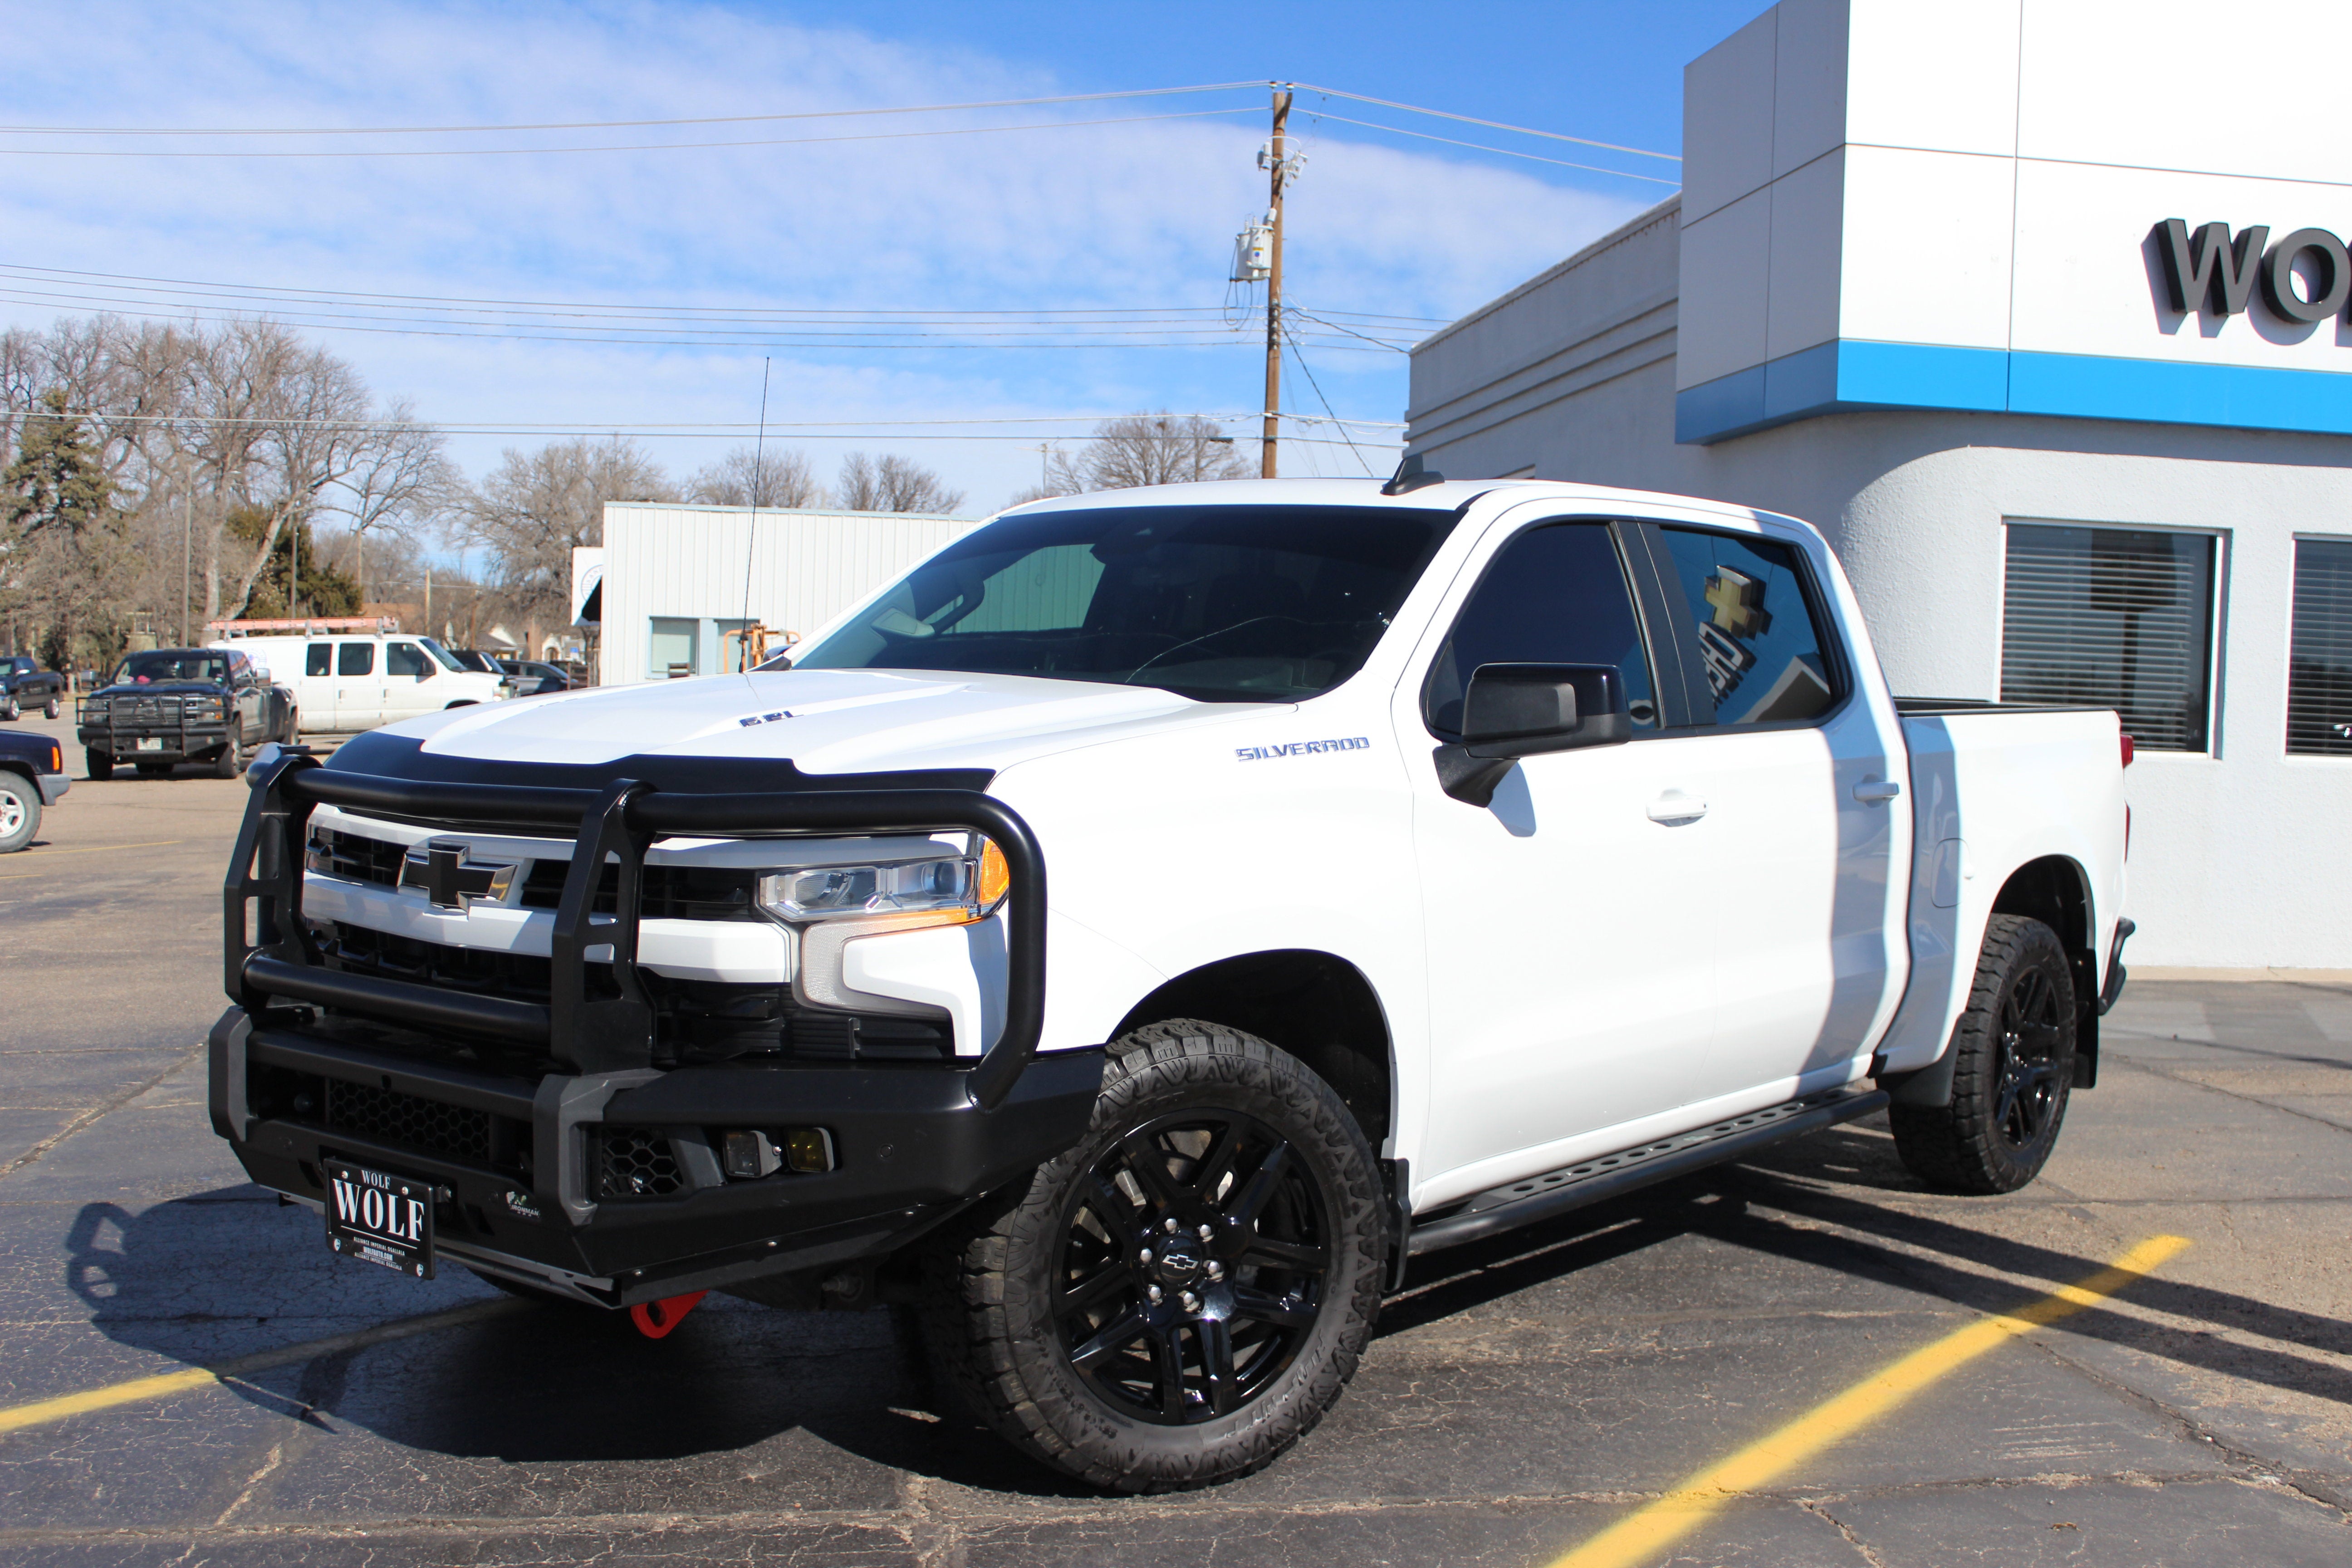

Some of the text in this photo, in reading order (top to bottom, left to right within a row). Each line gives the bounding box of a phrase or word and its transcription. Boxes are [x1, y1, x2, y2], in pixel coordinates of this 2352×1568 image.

[2152, 218, 2352, 324] WO
[1234, 736, 1370, 762] SILVERADO
[361, 1169, 391, 1190] WOLF
[333, 1178, 425, 1241] WOLF
[511, 1204, 539, 1216] IRONMAN
[353, 1236, 405, 1256] ALLIANCE IMPERIAL OGALLALA
[363, 1246, 393, 1261] WOLFAUTO.COM
[354, 1252, 402, 1271] ALLIANCE IMPERIAL OGALLALA
